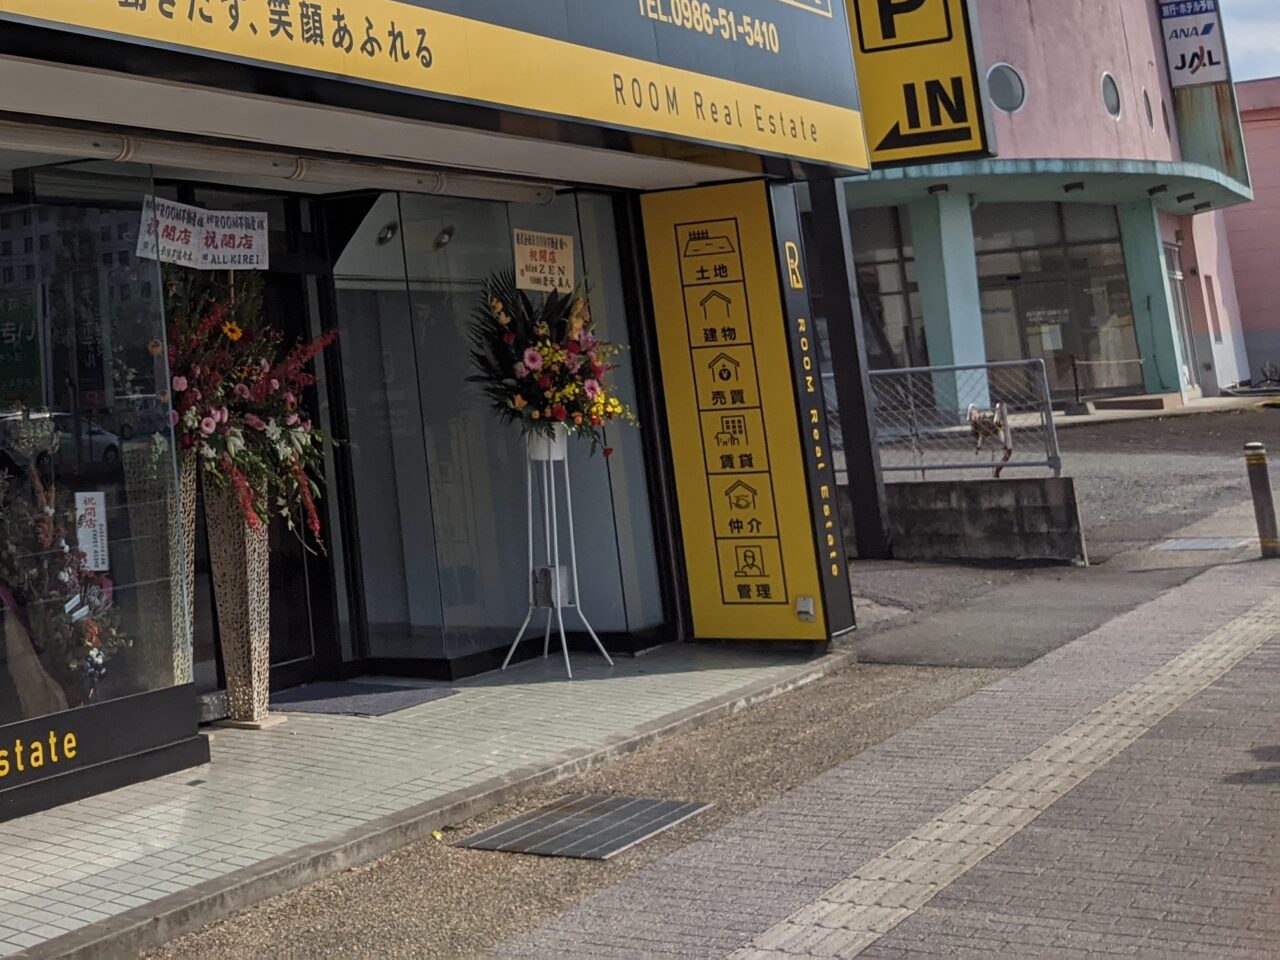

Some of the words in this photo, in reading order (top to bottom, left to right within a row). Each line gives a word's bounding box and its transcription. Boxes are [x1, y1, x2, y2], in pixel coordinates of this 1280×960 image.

[1168, 25, 1200, 40] ANA
[1174, 45, 1221, 74] JAL
[613, 73, 679, 117] ROOM
[694, 91, 743, 128] Real
[755, 104, 818, 142] Estate
[902, 76, 968, 129] IN
[204, 230, 254, 249] 祝開店
[231, 254, 260, 265] KIREI
[539, 264, 565, 276] ZEN
[696, 264, 729, 281] 土地
[703, 326, 737, 343] 建物
[797, 318, 815, 393] ROOM
[711, 390, 746, 406] 売買
[82, 496, 97, 529] 祝開店
[728, 518, 763, 534] 仲介
[736, 583, 772, 599] 管理
